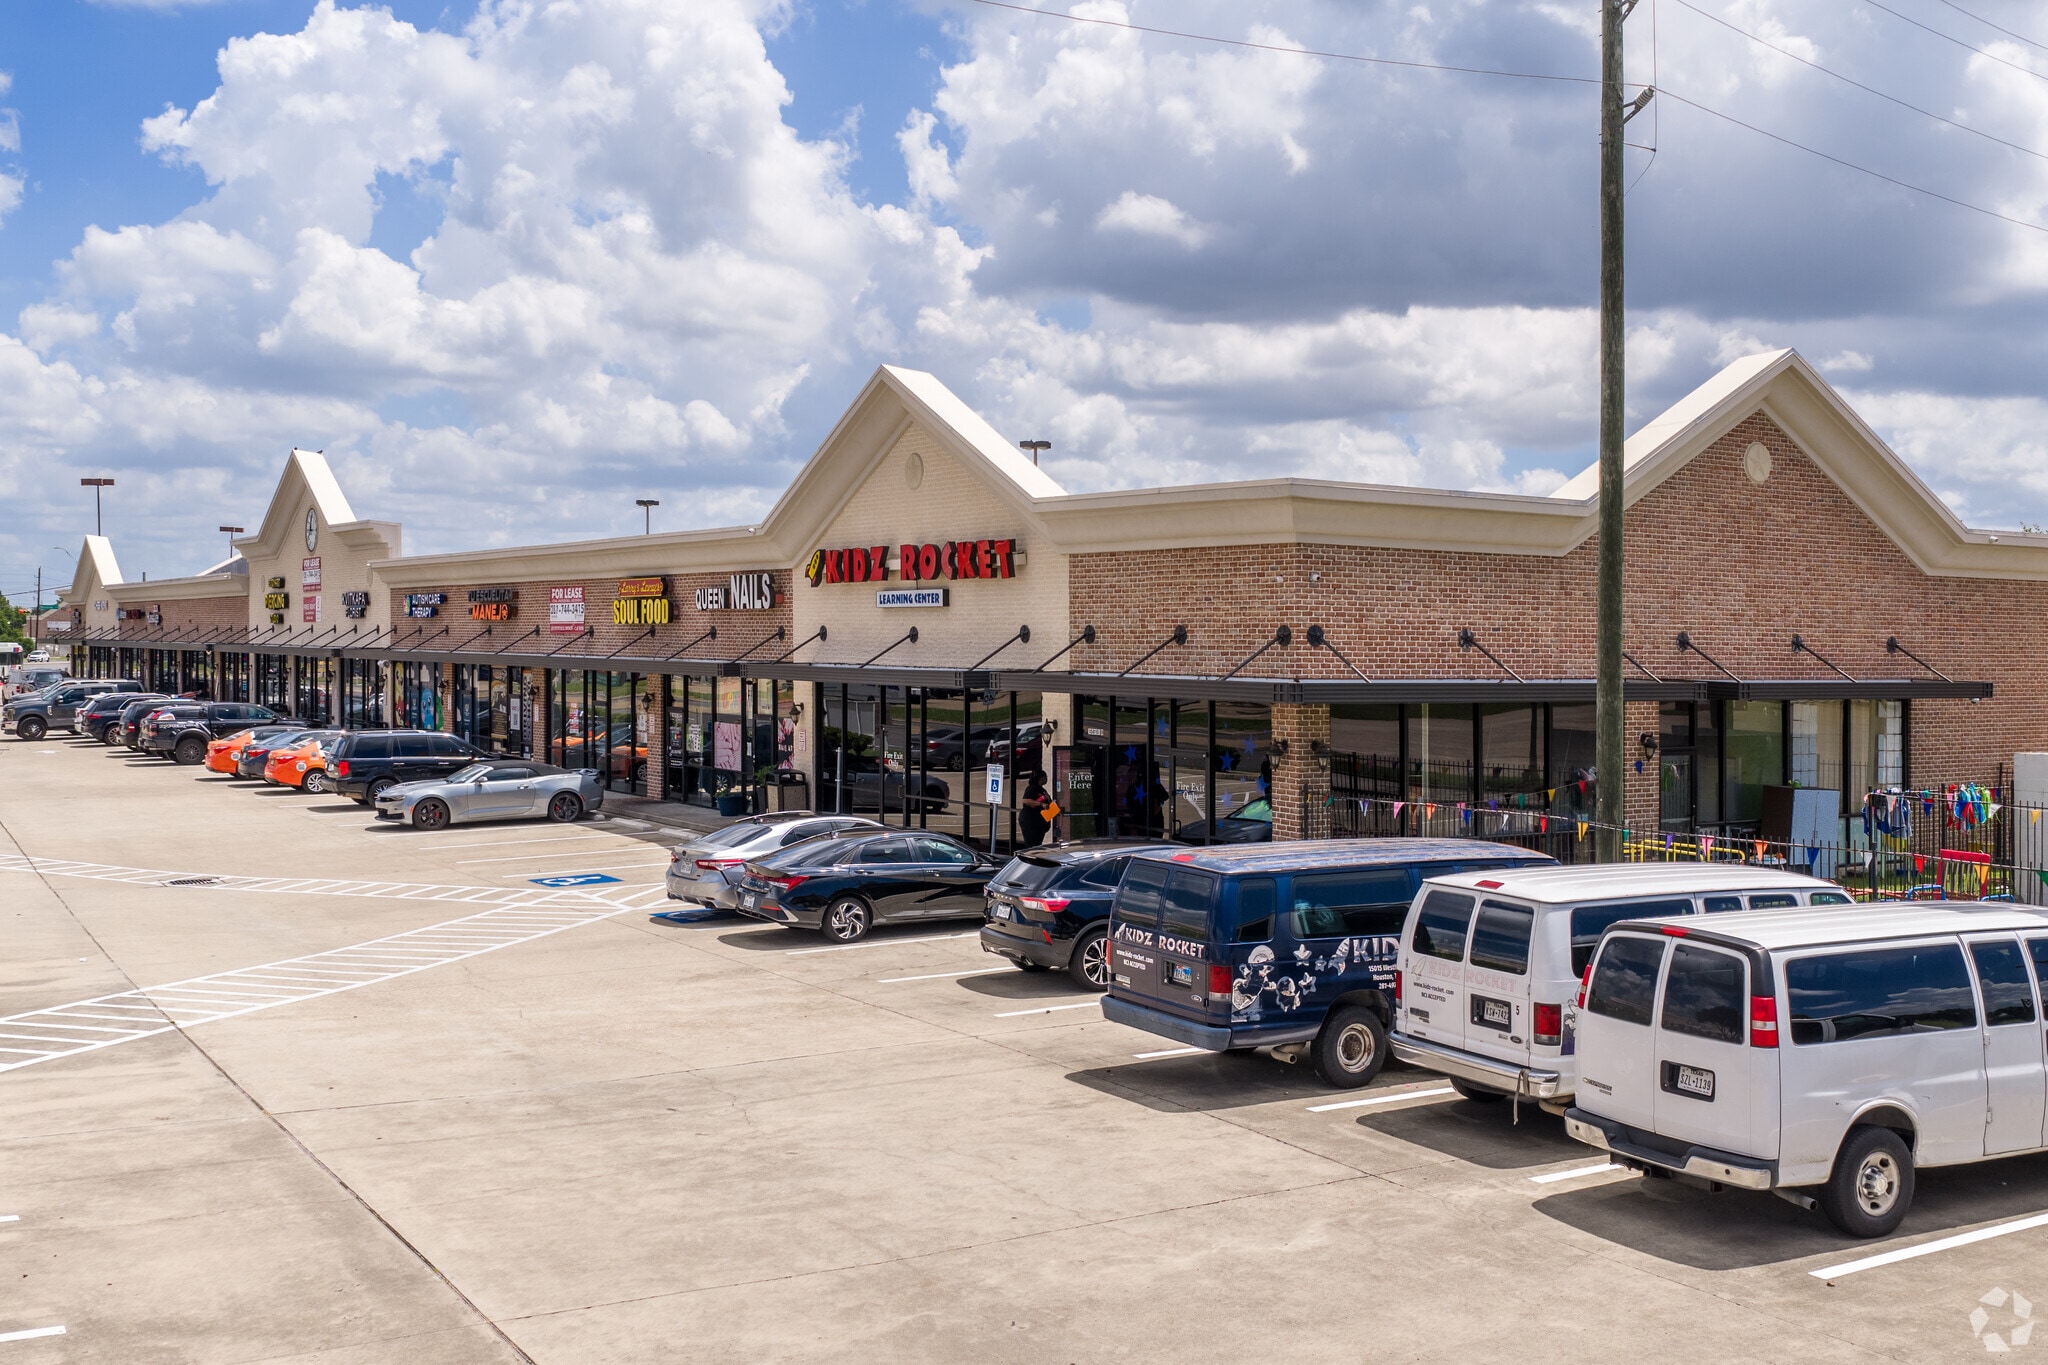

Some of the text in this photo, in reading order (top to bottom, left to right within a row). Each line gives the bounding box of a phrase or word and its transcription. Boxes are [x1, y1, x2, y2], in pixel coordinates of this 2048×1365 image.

[825, 539, 1014, 584] KIDZ ROCKET
[551, 587, 583, 599] FOR LEASE
[695, 573, 772, 611] QUEEN NAILS
[879, 591, 940, 605] LEARNING CENTER
[412, 607, 432, 617] THERAPY
[471, 603, 509, 620] MANEJO
[613, 598, 669, 625] SOUL FOOD
[884, 751, 904, 760] Fire Exit
[888, 759, 899, 769] Only
[1068, 772, 1094, 781] Enter
[1069, 781, 1092, 789] Here
[1176, 781, 1205, 792] Fire Exit
[1125, 927, 1205, 958] KIDZ ROCKET
[1465, 969, 1517, 993] ROCKET
[1516, 1005, 1520, 1016] 5
[1690, 1069, 1704, 1077] TEXAS
